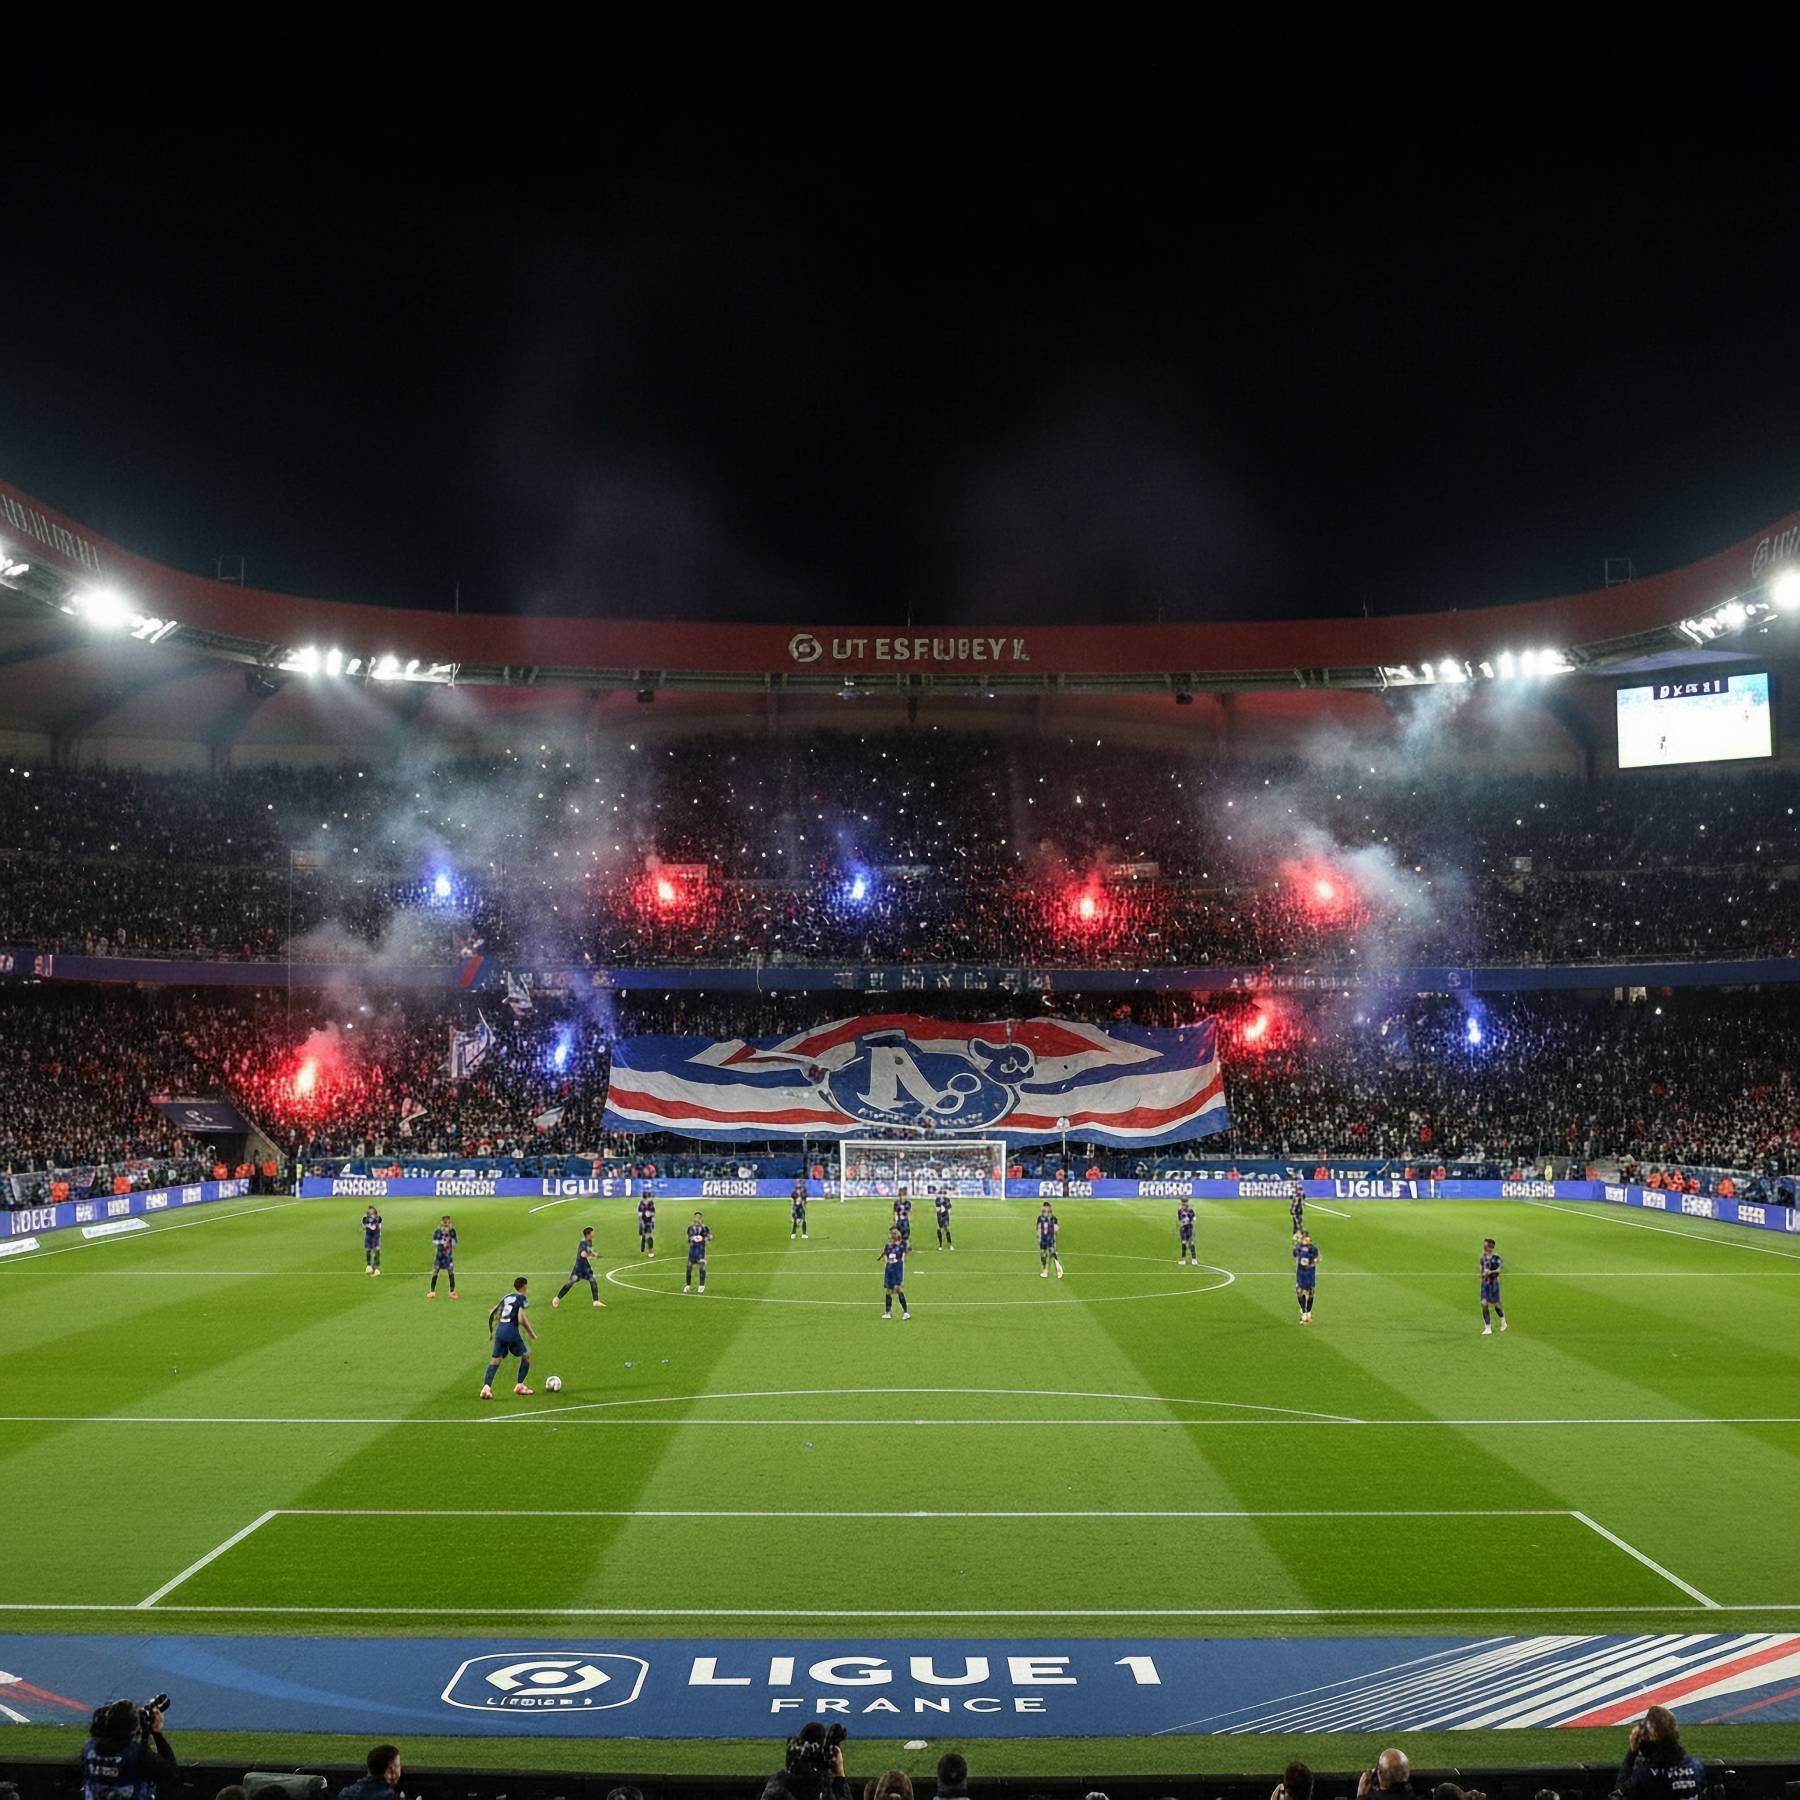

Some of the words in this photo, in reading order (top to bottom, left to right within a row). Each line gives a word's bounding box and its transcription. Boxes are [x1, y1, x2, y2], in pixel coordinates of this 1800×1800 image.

[688, 1656, 1077, 1686] LIGUE
[1114, 1656, 1162, 1685] 1
[770, 1697, 1047, 1713] FRANCE
